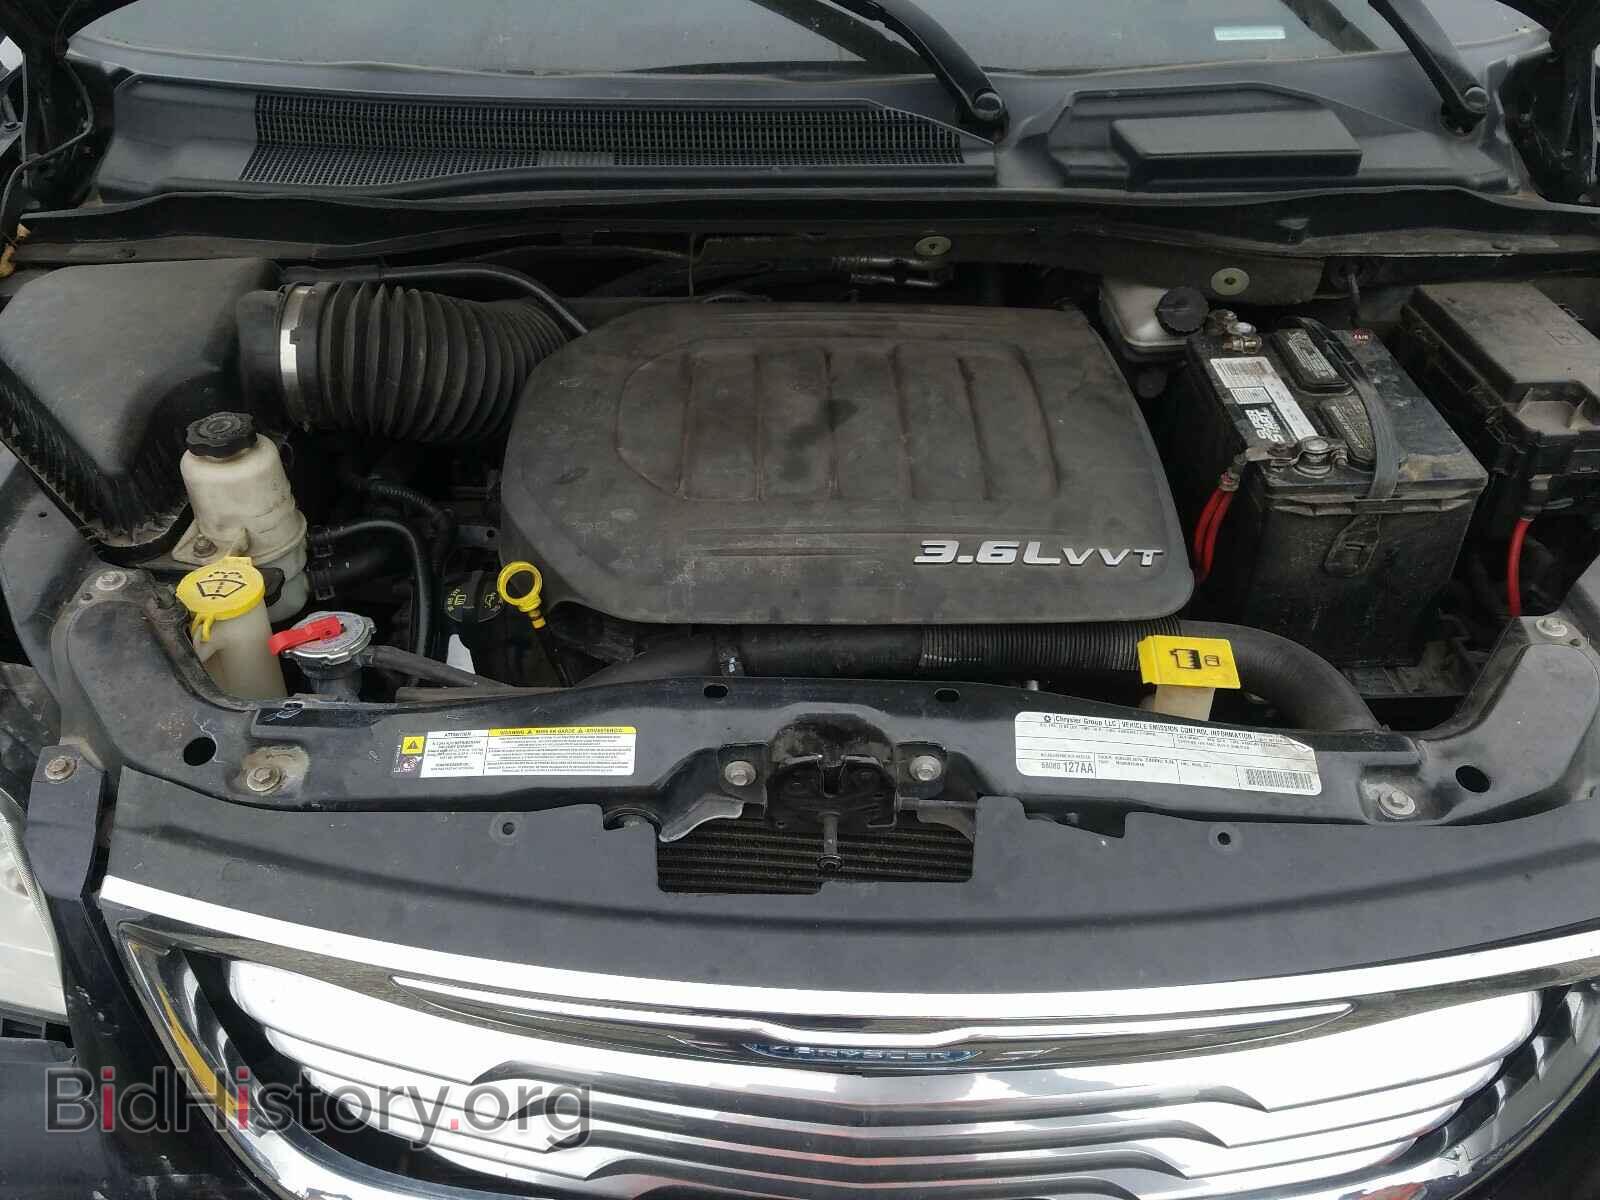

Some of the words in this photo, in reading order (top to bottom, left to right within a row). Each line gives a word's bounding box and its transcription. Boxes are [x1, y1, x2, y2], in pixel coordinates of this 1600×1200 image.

[1083, 718, 1103, 727] Group
[1104, 719, 1117, 727] LLC
[1121, 720, 1148, 730] VEHICLE
[1149, 723, 1179, 733] EMISSION
[1180, 726, 1209, 736] CONTROL
[1210, 729, 1253, 740] INFORMATION
[1063, 761, 1094, 774] 127AA
